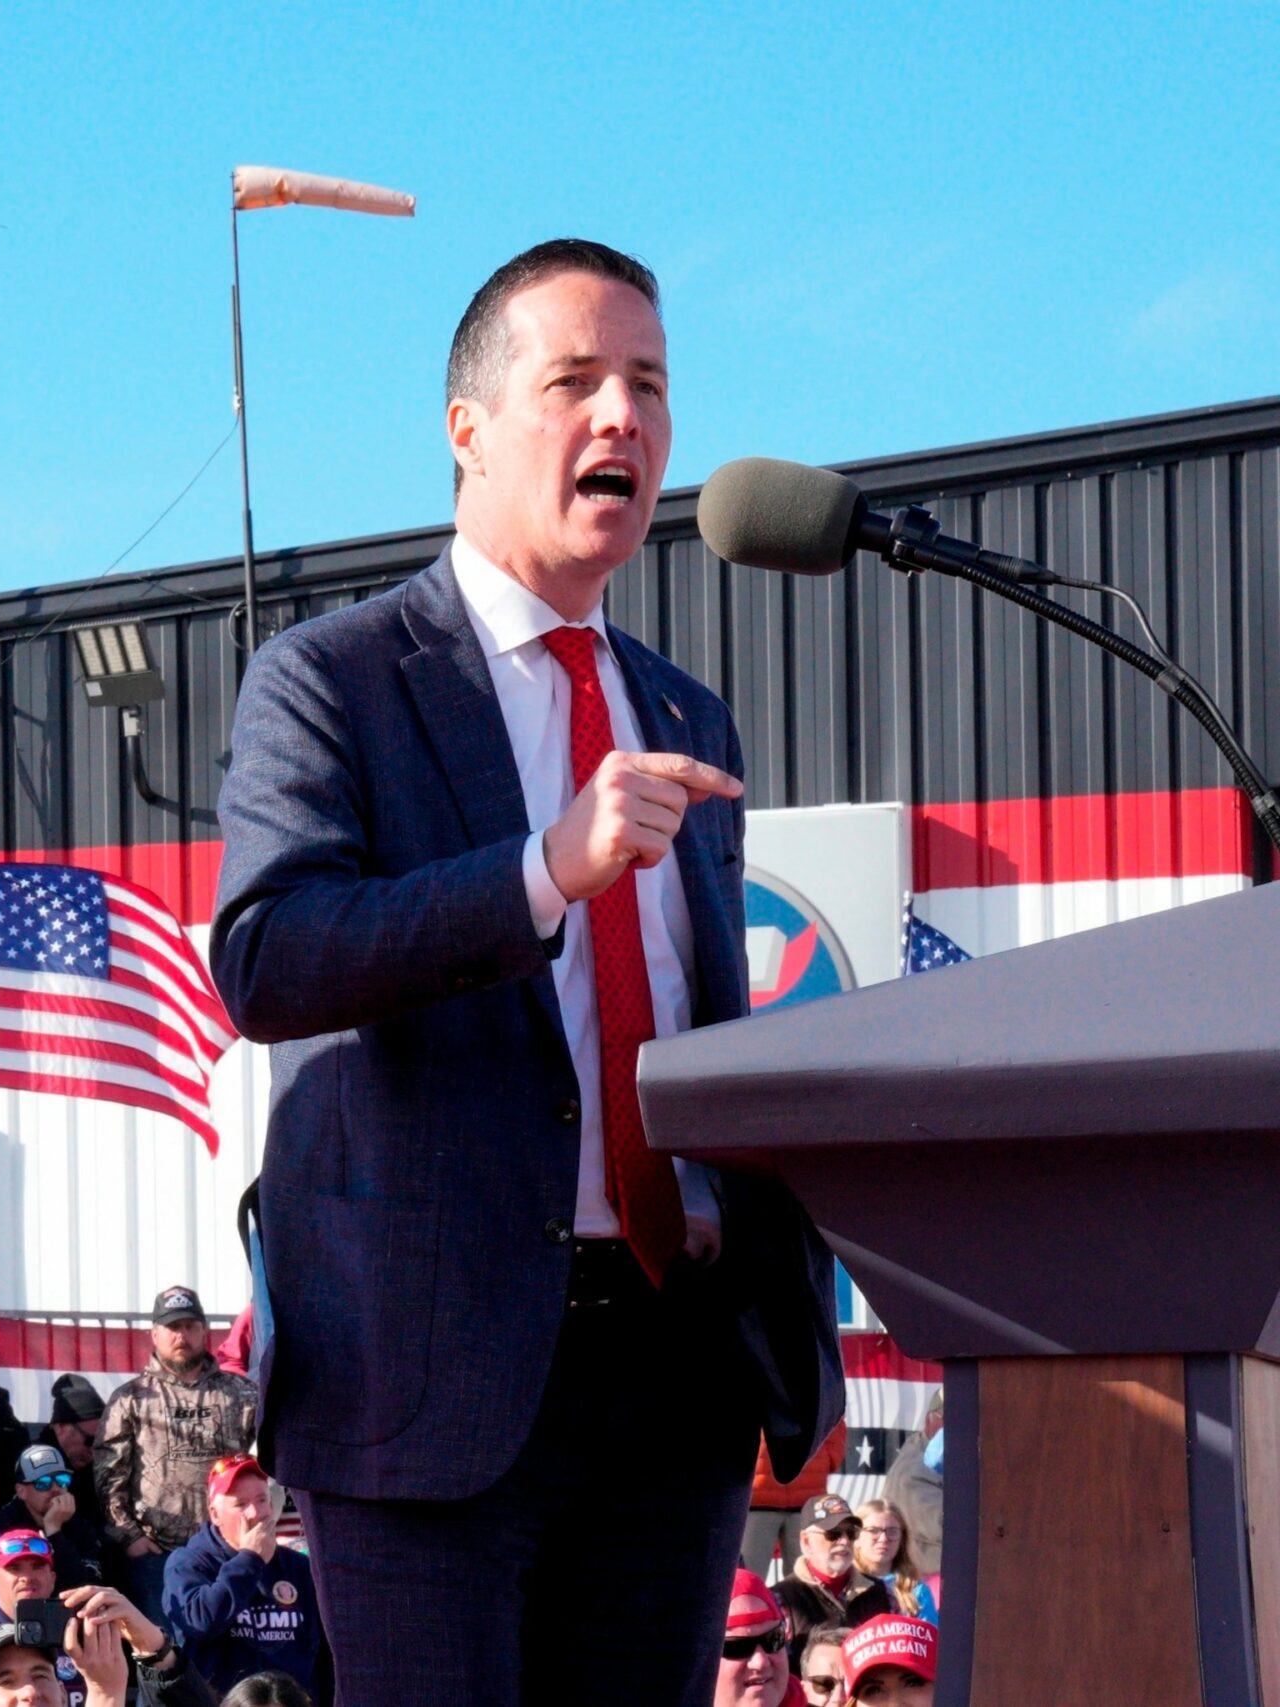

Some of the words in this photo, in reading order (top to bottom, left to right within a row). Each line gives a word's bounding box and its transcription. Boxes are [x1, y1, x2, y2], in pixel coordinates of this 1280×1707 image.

[174, 1408, 212, 1419] BIG
[845, 1627, 875, 1657] MAKE
[875, 1621, 933, 1642] AMERICA
[852, 1641, 886, 1669] GREAT
[888, 1639, 927, 1658] AGAIN
